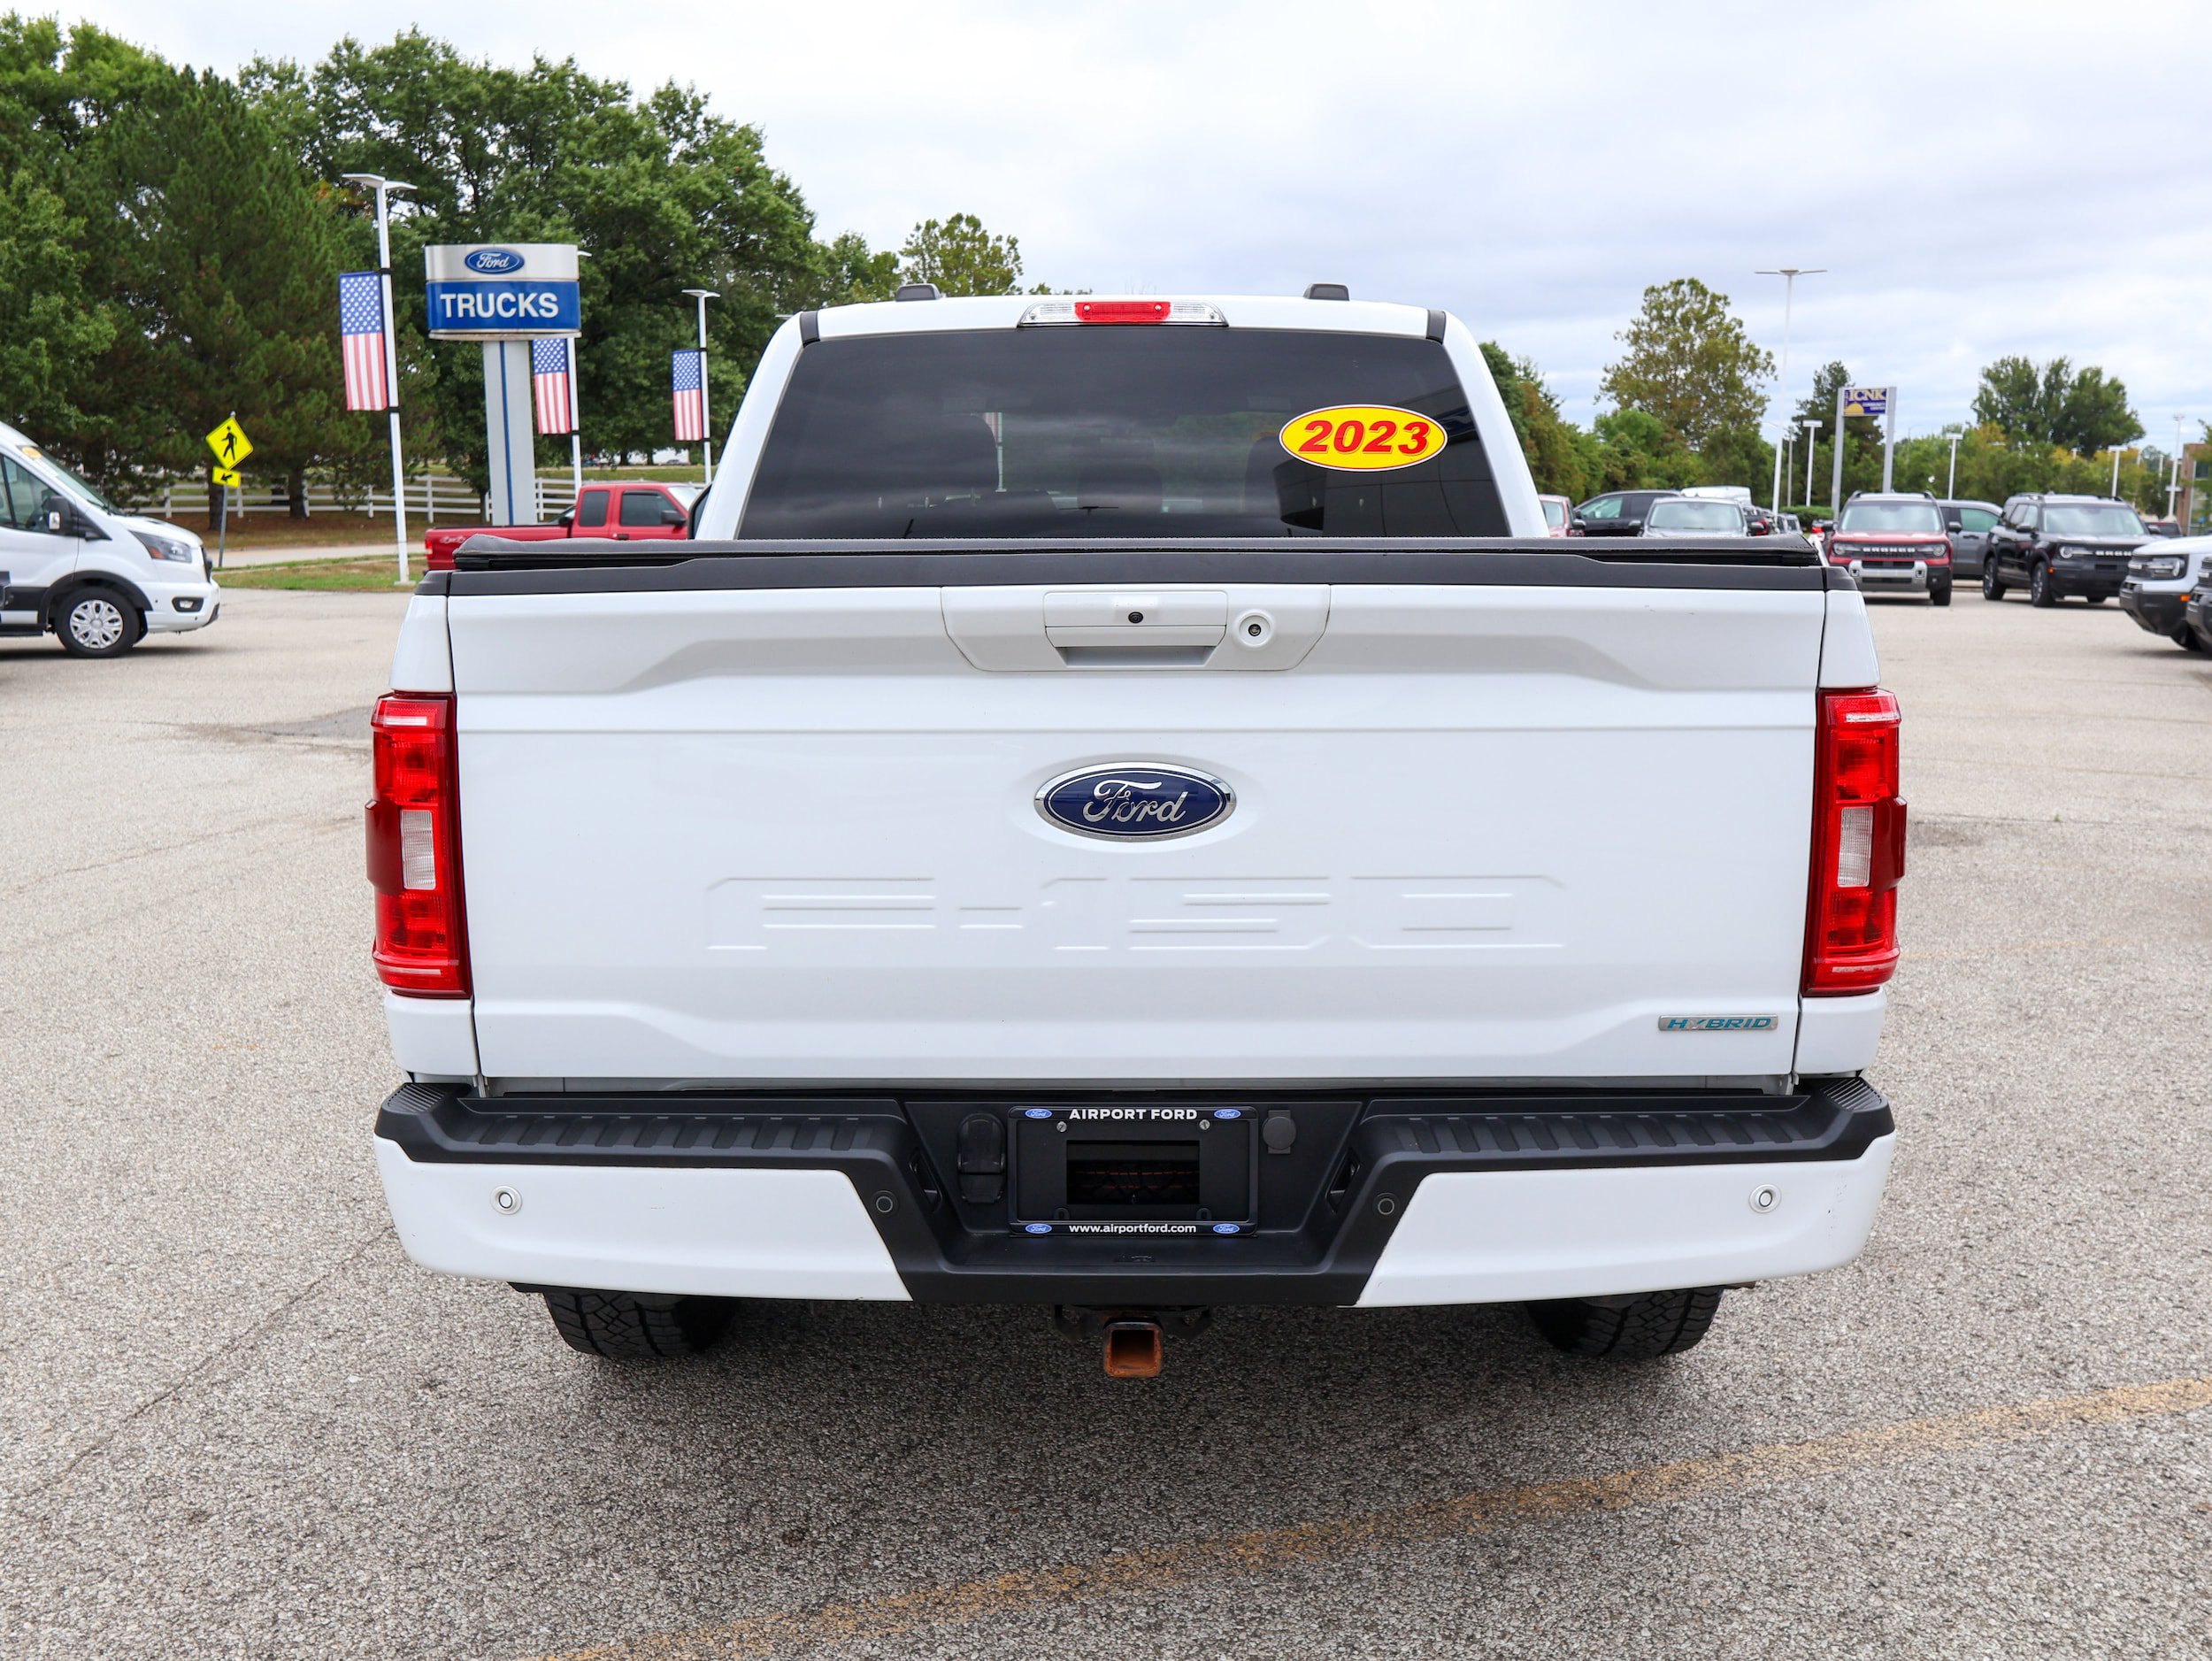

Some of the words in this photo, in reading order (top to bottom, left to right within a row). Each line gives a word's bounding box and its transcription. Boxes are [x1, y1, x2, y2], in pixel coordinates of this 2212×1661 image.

[476, 253, 510, 268] Ford
[440, 292, 559, 319] TRUCKS
[1298, 419, 1430, 456] 2023
[1083, 779, 1189, 823] Ford
[1667, 1019, 1772, 1029] HYBRID
[1069, 1108, 1147, 1120] AIRPORT
[1150, 1109, 1198, 1120] FORD
[1068, 1223, 1197, 1234] www.airportford.com
